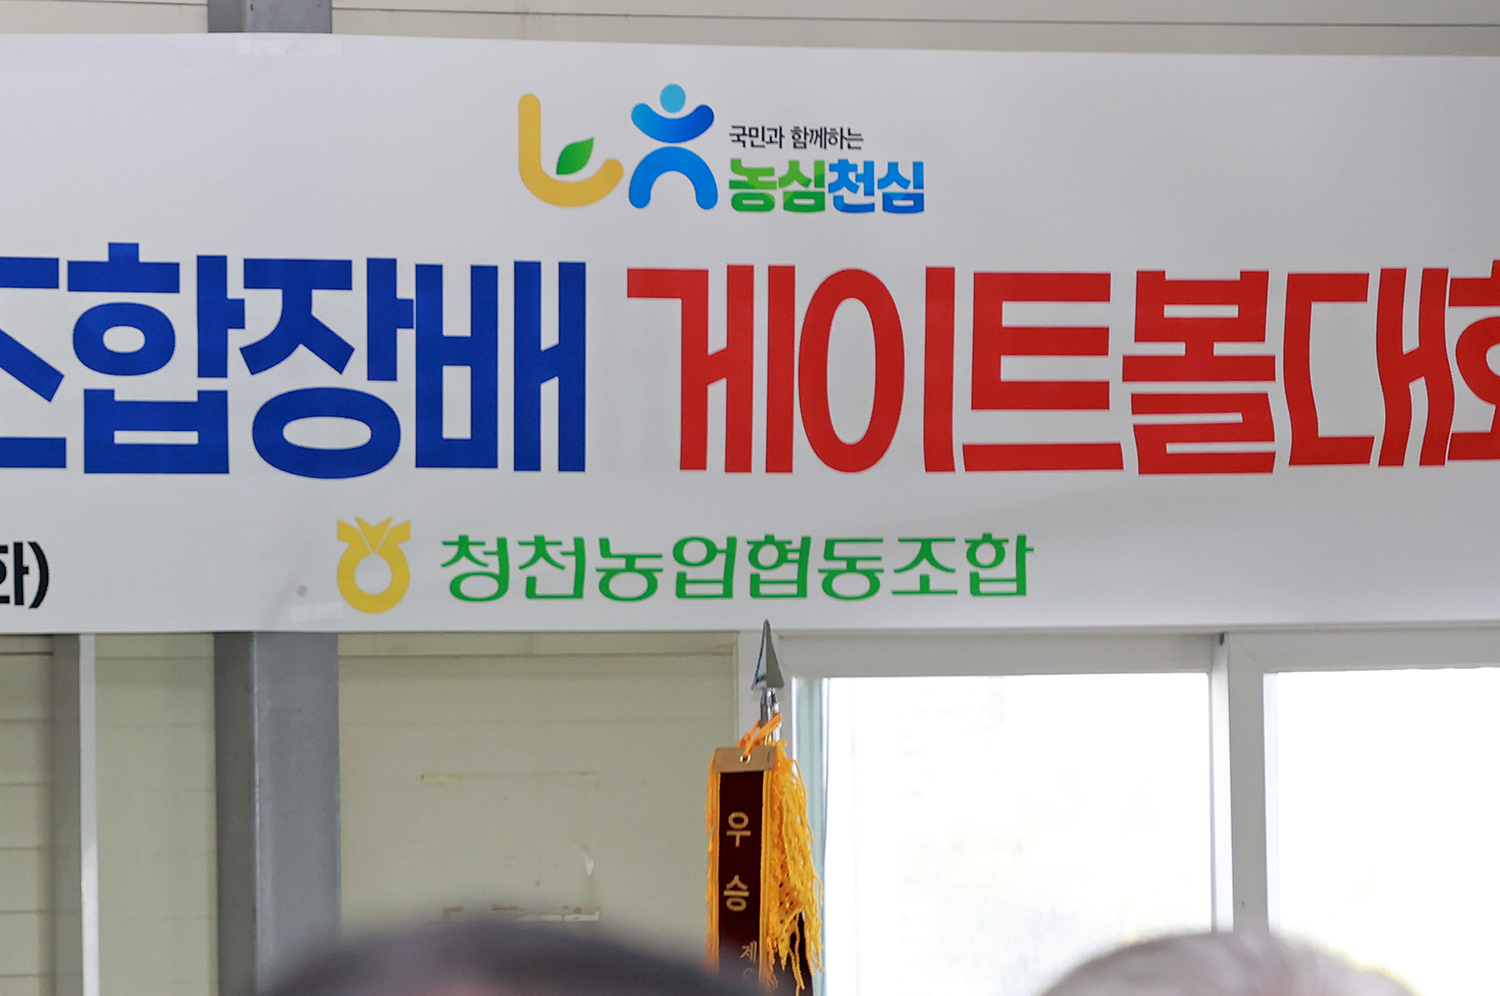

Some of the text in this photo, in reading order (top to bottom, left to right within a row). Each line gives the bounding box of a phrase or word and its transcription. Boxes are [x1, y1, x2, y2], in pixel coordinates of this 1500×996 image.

[729, 125, 864, 150] 국민과 함께하는
[729, 158, 924, 214] 농심천심
[440, 533, 1035, 603] 청천농업협동조합
